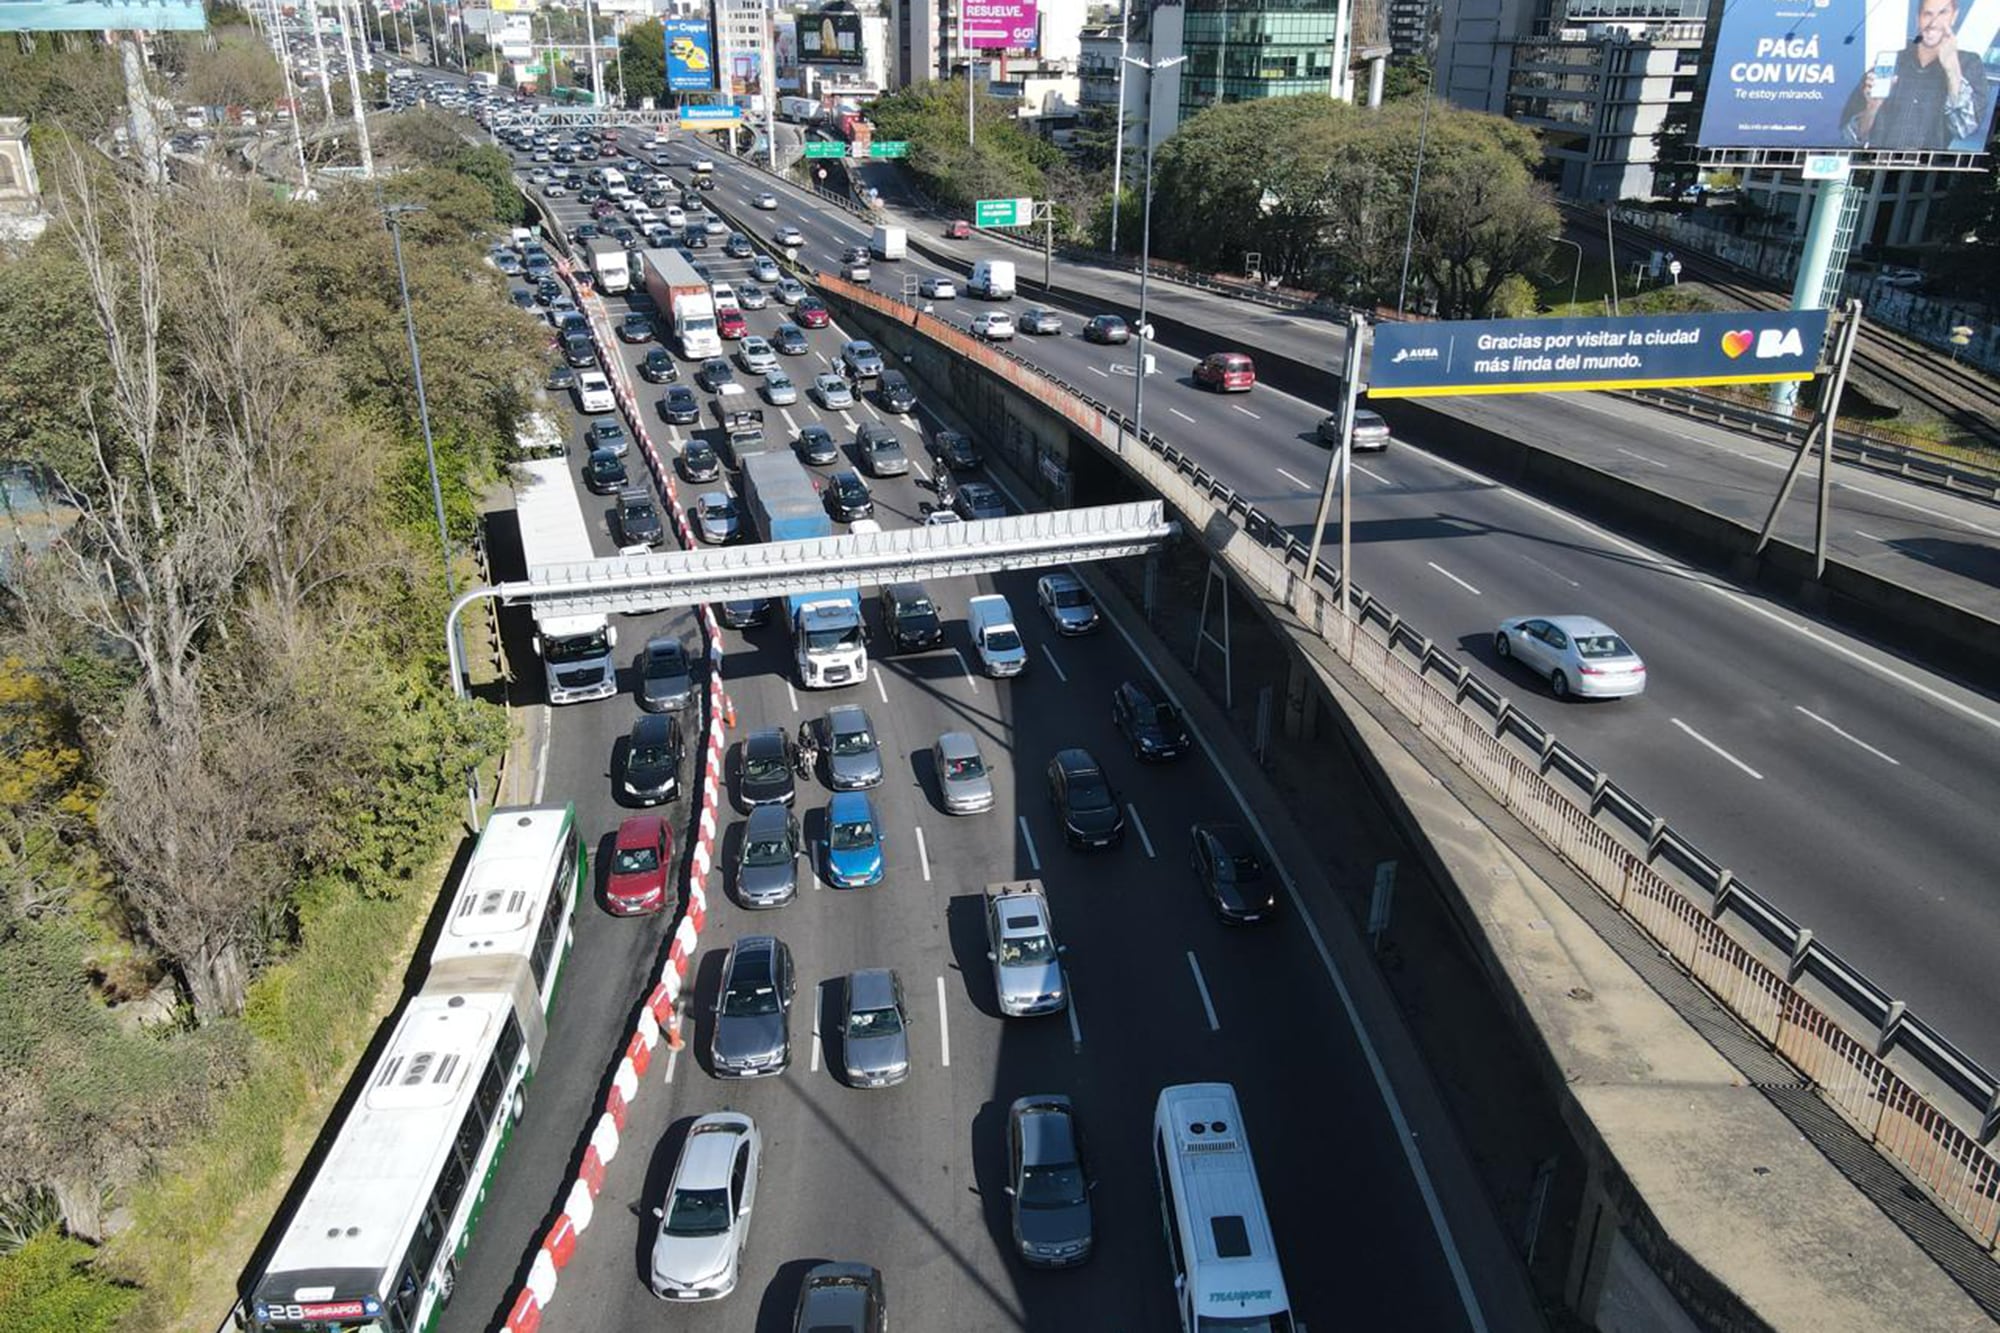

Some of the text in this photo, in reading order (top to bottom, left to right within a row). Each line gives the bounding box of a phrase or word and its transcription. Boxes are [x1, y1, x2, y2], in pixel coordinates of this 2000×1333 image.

[966, 5, 1024, 17] RESUELVE.
[1757, 34, 1819, 58] PAGÁ
[1730, 62, 1835, 83] CON VISA
[1735, 88, 1823, 101] Te estoy mirando.
[1477, 328, 1700, 351] Gracias por visitar la ciudad
[1756, 328, 1804, 358] BA
[1408, 348, 1439, 357] AUSA
[1474, 352, 1642, 373] más linda del mundo.
[268, 1304, 303, 1320] 28
